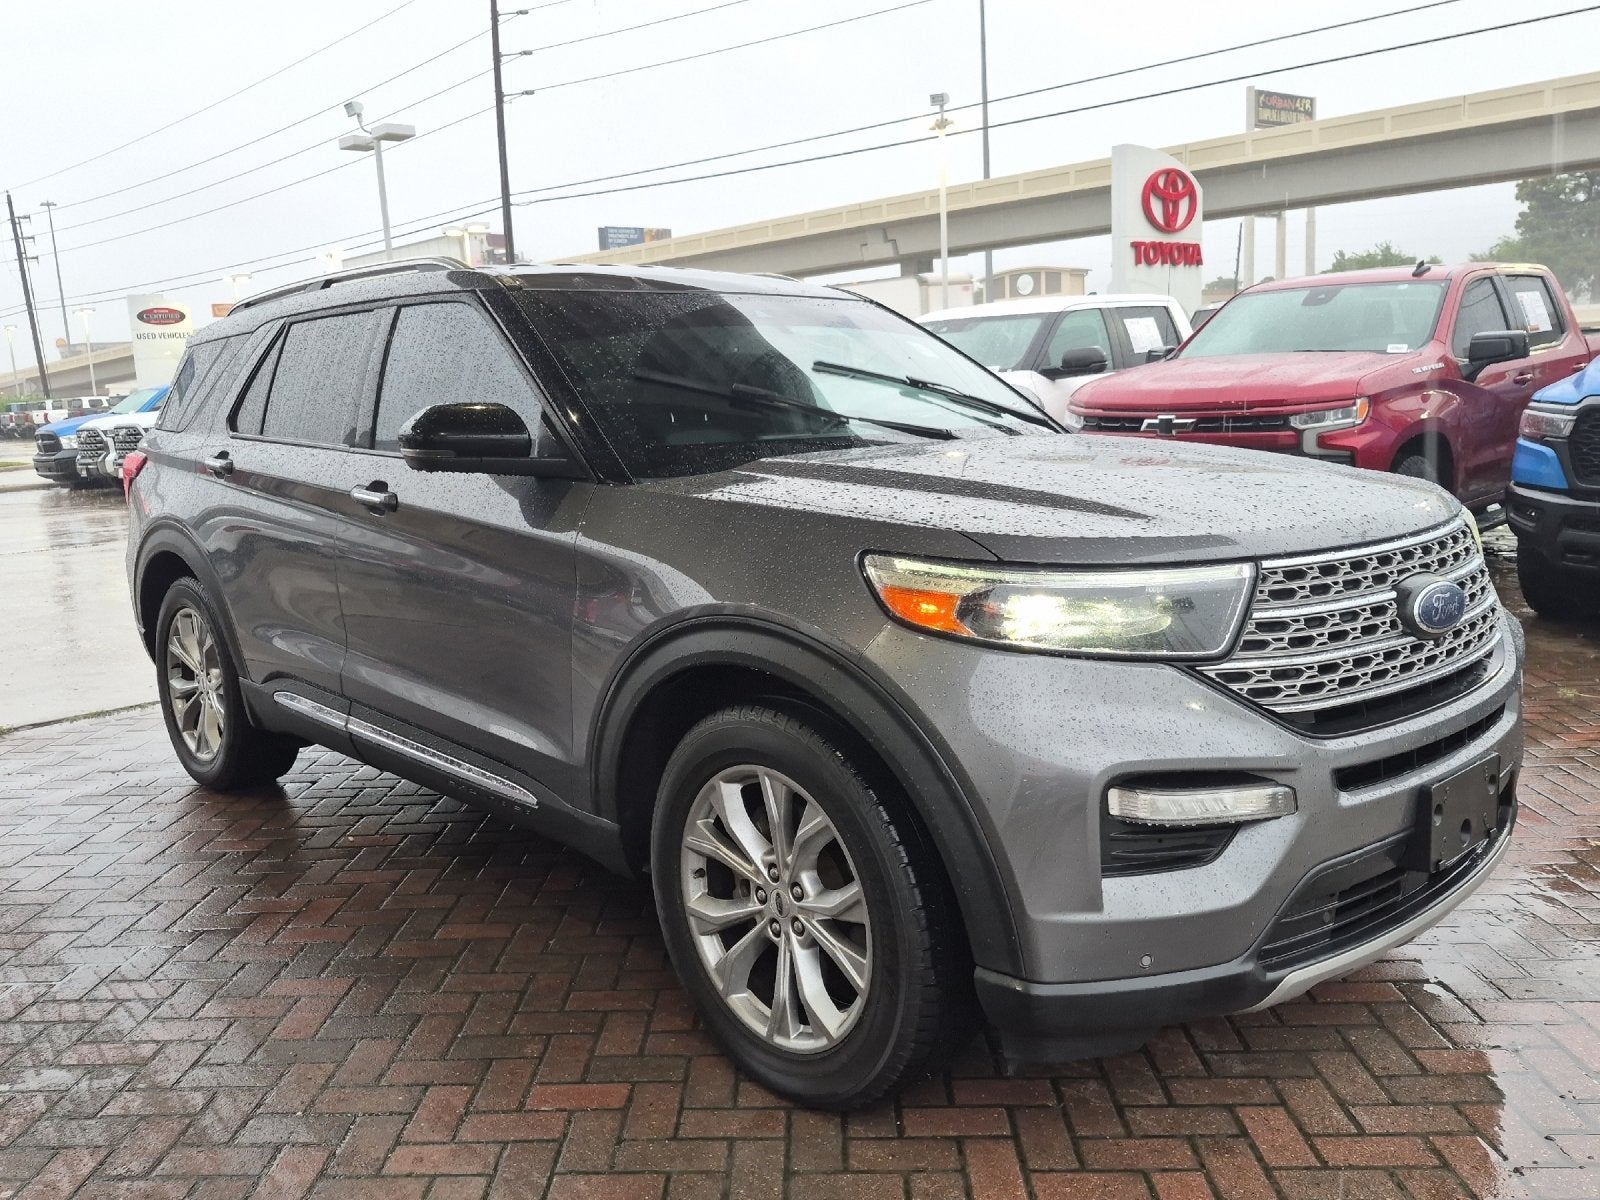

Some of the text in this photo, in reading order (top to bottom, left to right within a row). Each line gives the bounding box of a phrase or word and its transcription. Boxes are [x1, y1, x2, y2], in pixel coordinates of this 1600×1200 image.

[1130, 241, 1203, 266] TOYOTA
[136, 332, 157, 340] USED
[1432, 592, 1459, 622] Ford
